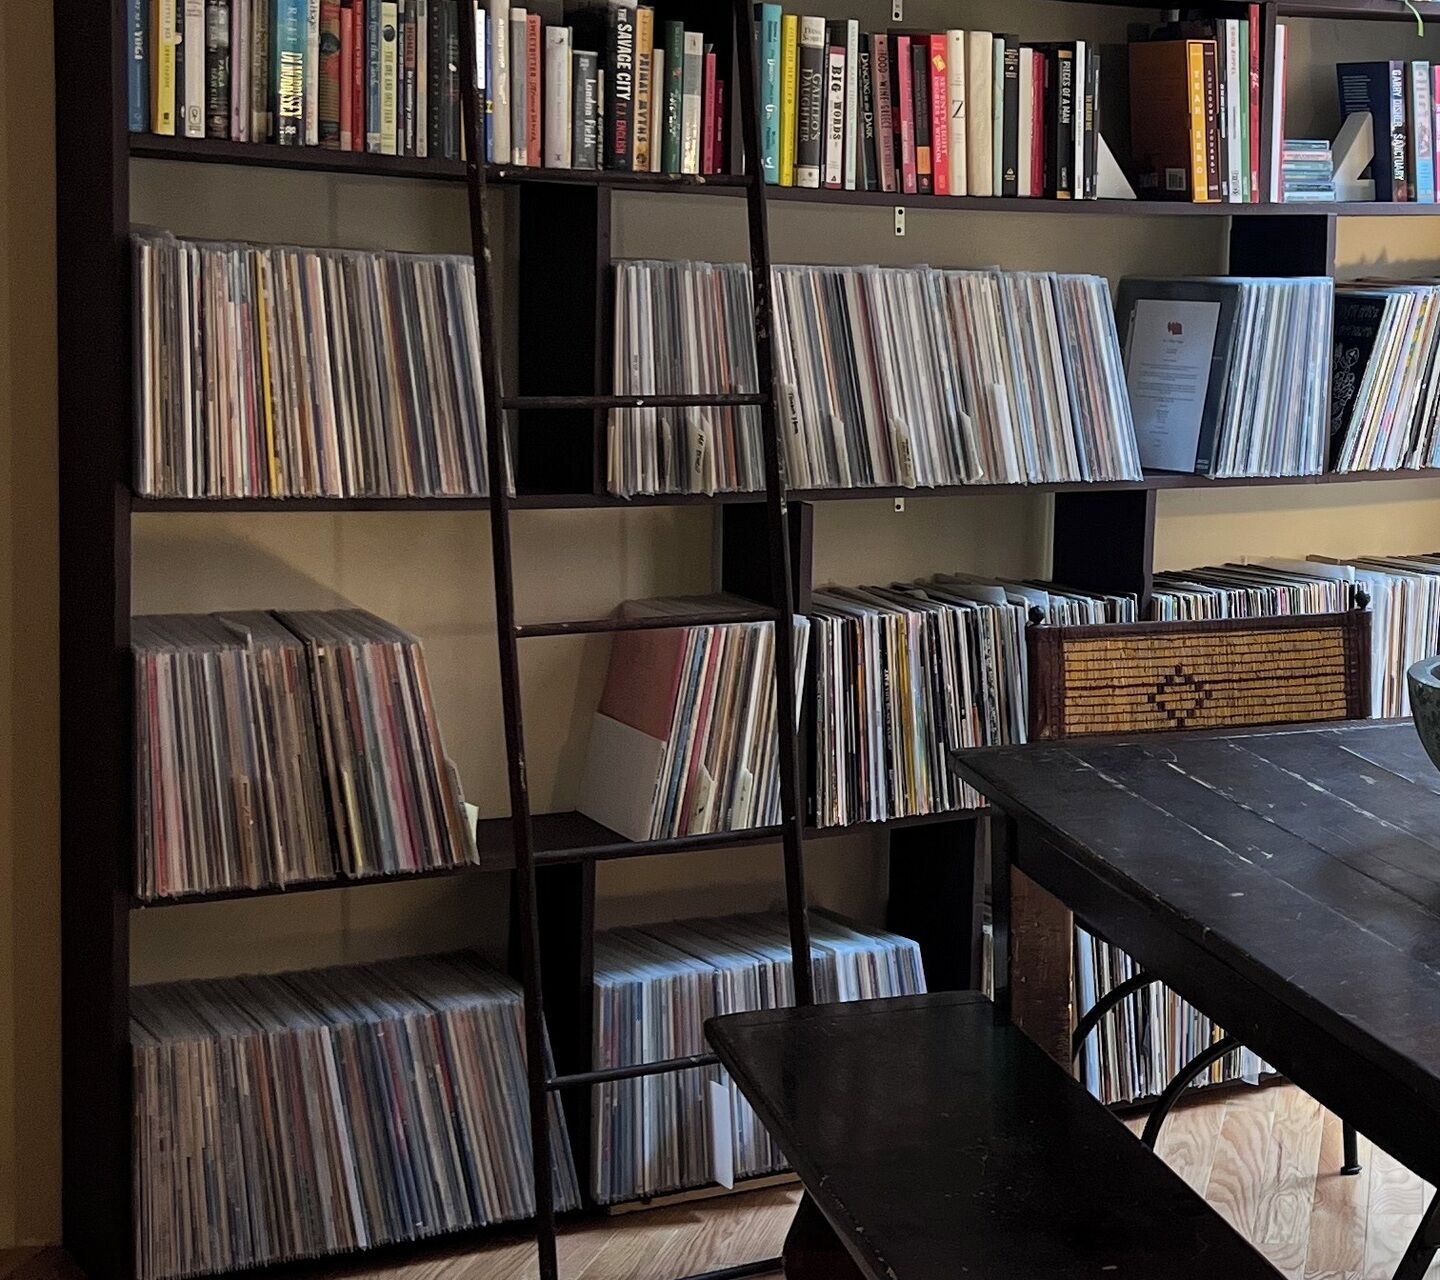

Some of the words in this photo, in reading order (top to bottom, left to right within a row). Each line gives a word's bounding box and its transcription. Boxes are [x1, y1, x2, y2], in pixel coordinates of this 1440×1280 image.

[617, 8, 627, 22] THE
[134, 31, 143, 60] YOGI
[209, 18, 217, 52] TRAIN
[616, 24, 632, 69] SAVAGE
[280, 51, 302, 64] DI
[639, 53, 649, 95] PRIMAL
[861, 53, 870, 95] DANCING
[1062, 61, 1071, 86] PIECES
[210, 68, 218, 110] HAWKINS
[278, 65, 302, 119] MORRISSEY
[615, 72, 630, 100] CITY
[831, 65, 841, 92] BIG
[880, 80, 888, 100] WINE
[1063, 88, 1070, 97] OF
[1392, 70, 1402, 96] GARRY
[584, 79, 596, 116] London
[801, 68, 812, 142] DAUGHTER
[811, 73, 821, 141] GALILEO'S
[584, 119, 595, 148] Fields
[638, 99, 647, 143] MYTHS
[832, 101, 841, 141] WORDS
[863, 112, 873, 139] DARK
[881, 105, 891, 129] GREECE
[615, 120, 625, 154] ENGLISH
[1392, 134, 1405, 181] SANCTUARY
